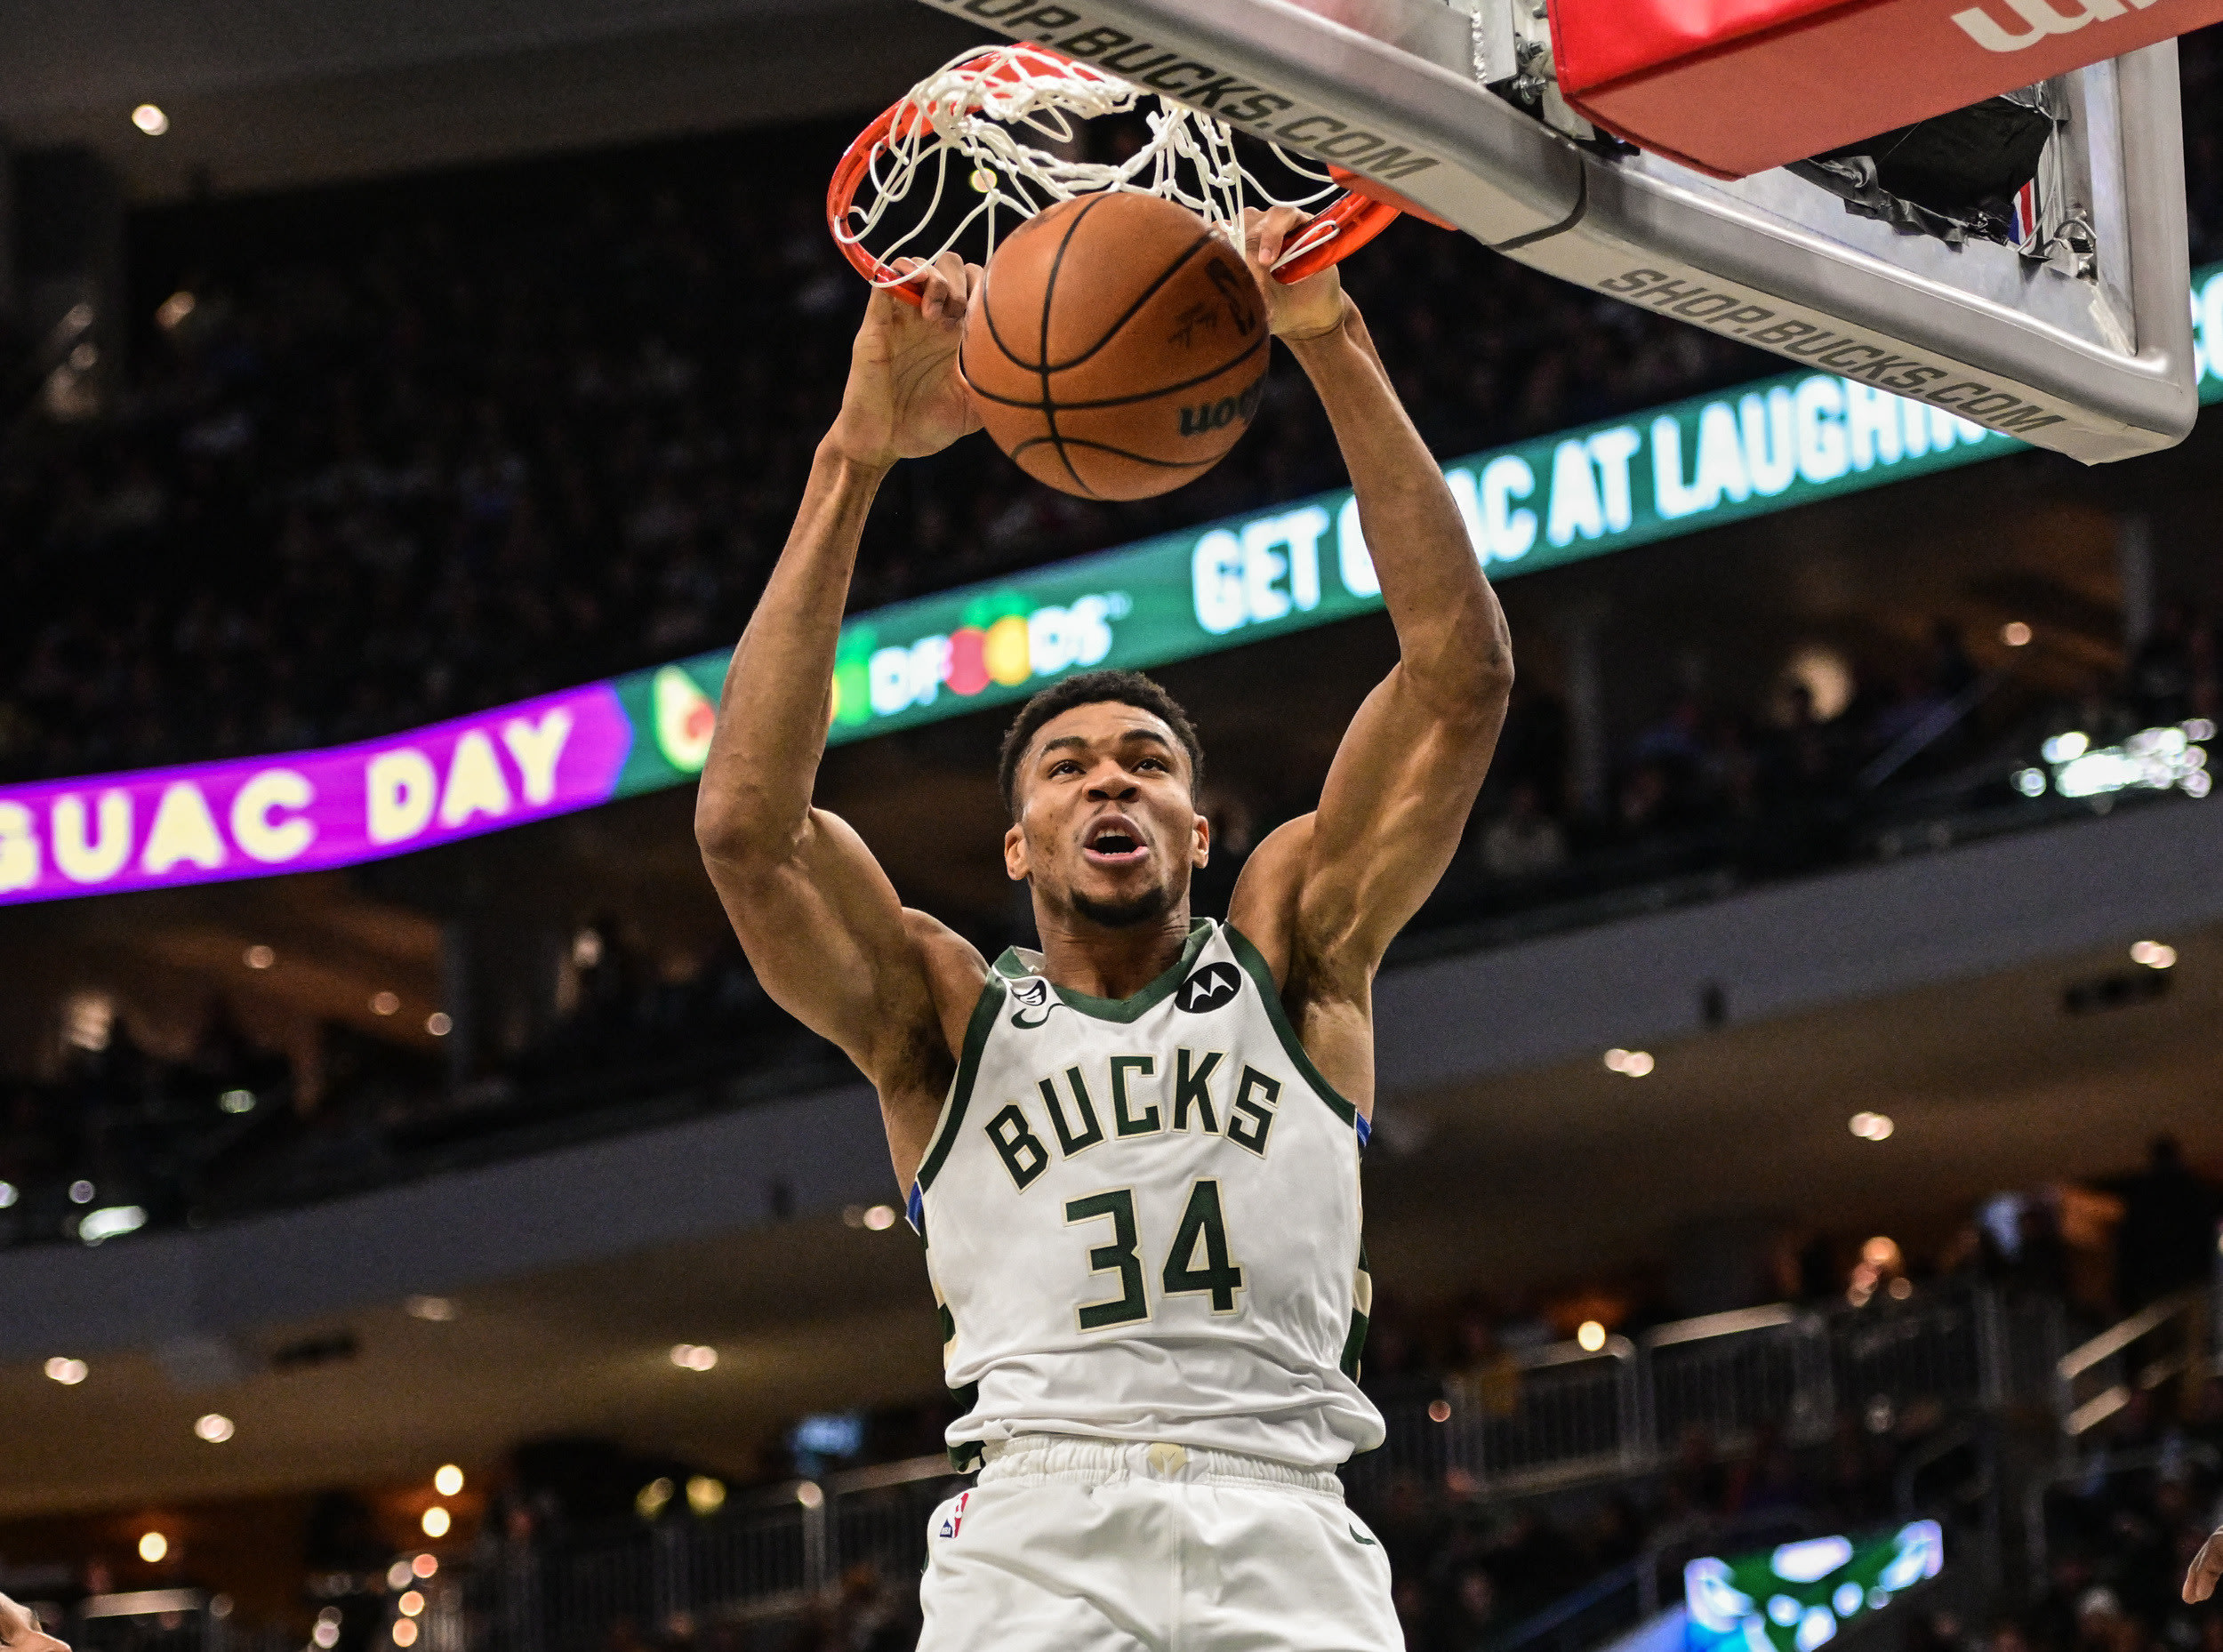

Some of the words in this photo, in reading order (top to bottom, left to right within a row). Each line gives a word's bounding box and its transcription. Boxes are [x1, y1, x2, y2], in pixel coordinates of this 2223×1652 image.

[938, 0, 1441, 179] OP.BUCKS.COM
[1601, 269, 2067, 433] SHOP.BUCKS.COM
[1192, 504, 1330, 635] GET
[1545, 427, 1641, 548] AT
[1651, 375, 2011, 520] LAUGHI
[365, 709, 572, 844] DAY
[984, 1047, 1284, 1194] BUCKS
[1063, 1177, 1246, 1335] 34
